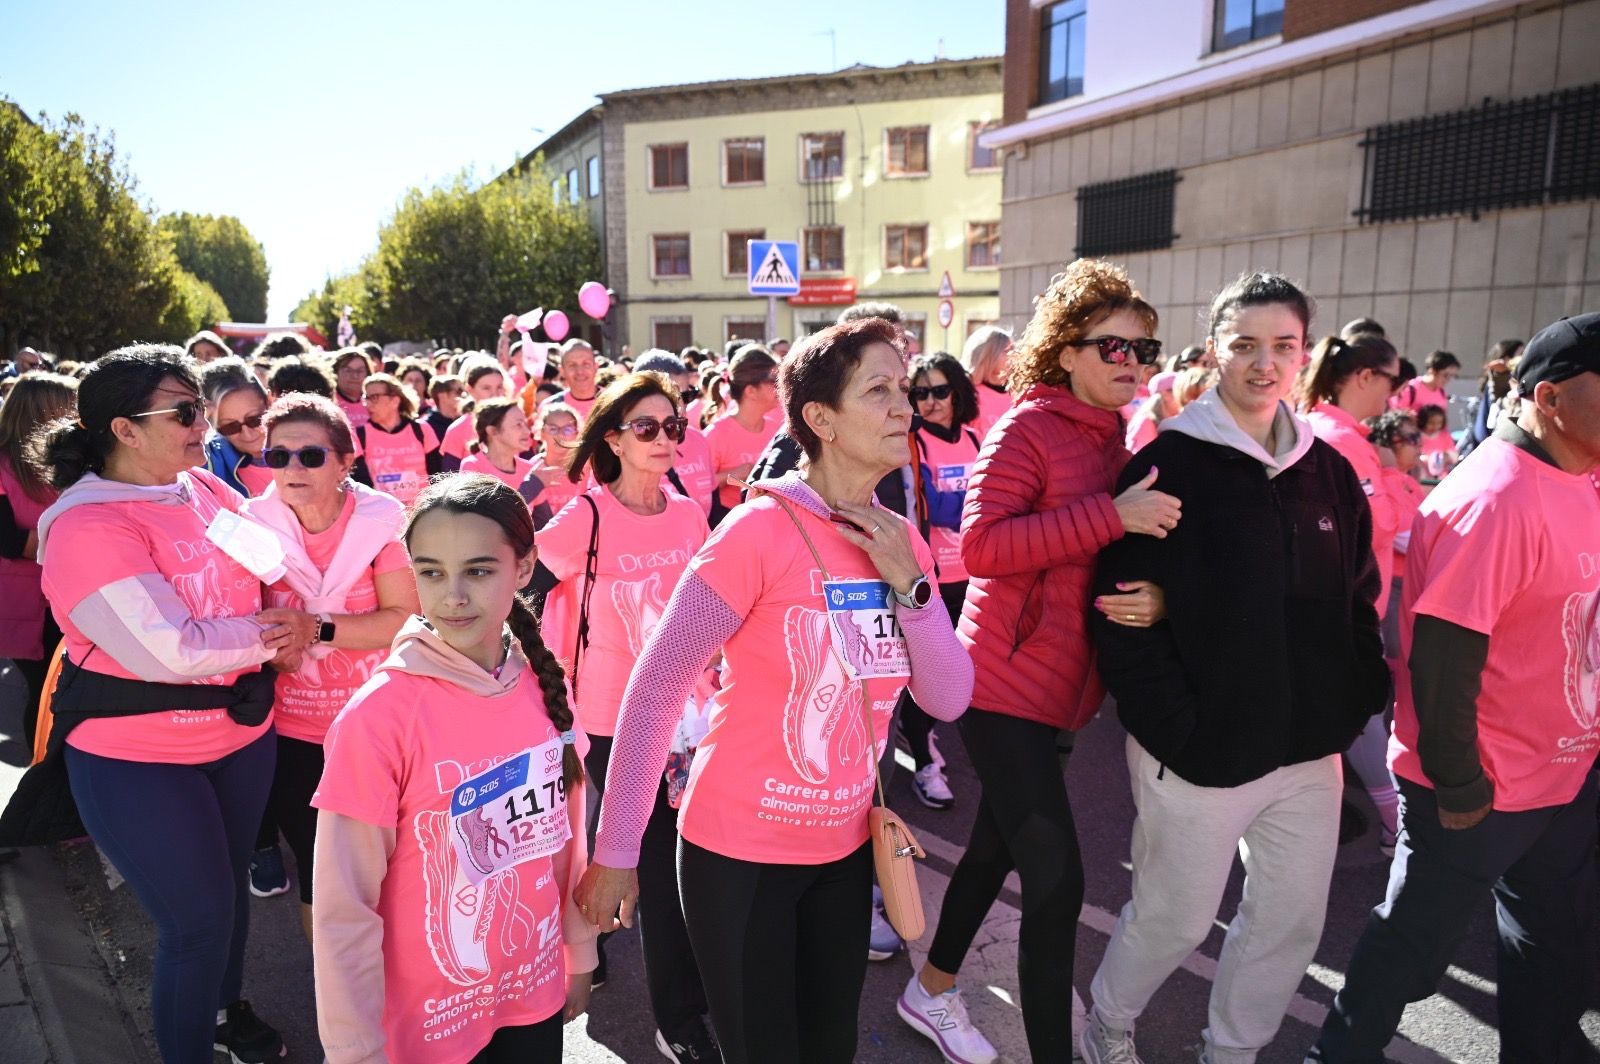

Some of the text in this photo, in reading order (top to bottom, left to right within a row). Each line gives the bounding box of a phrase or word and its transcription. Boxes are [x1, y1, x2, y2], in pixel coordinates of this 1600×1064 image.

[956, 478, 969, 490] 27
[873, 614, 905, 638] 17
[544, 761, 563, 775] almo
[460, 777, 501, 807] hp SCDS
[504, 775, 567, 826] 1179
[764, 777, 831, 801] Carrera
[833, 785, 850, 801] de
[760, 795, 811, 814] almom
[541, 826, 554, 836] de
[757, 811, 802, 826] Contra
[805, 819, 817, 827] el
[423, 949, 560, 1029] almom RASANVI
[424, 984, 494, 1014] Carrera
[517, 963, 532, 976] la
[424, 1018, 468, 1042] Contra
[471, 1009, 484, 1020] el
